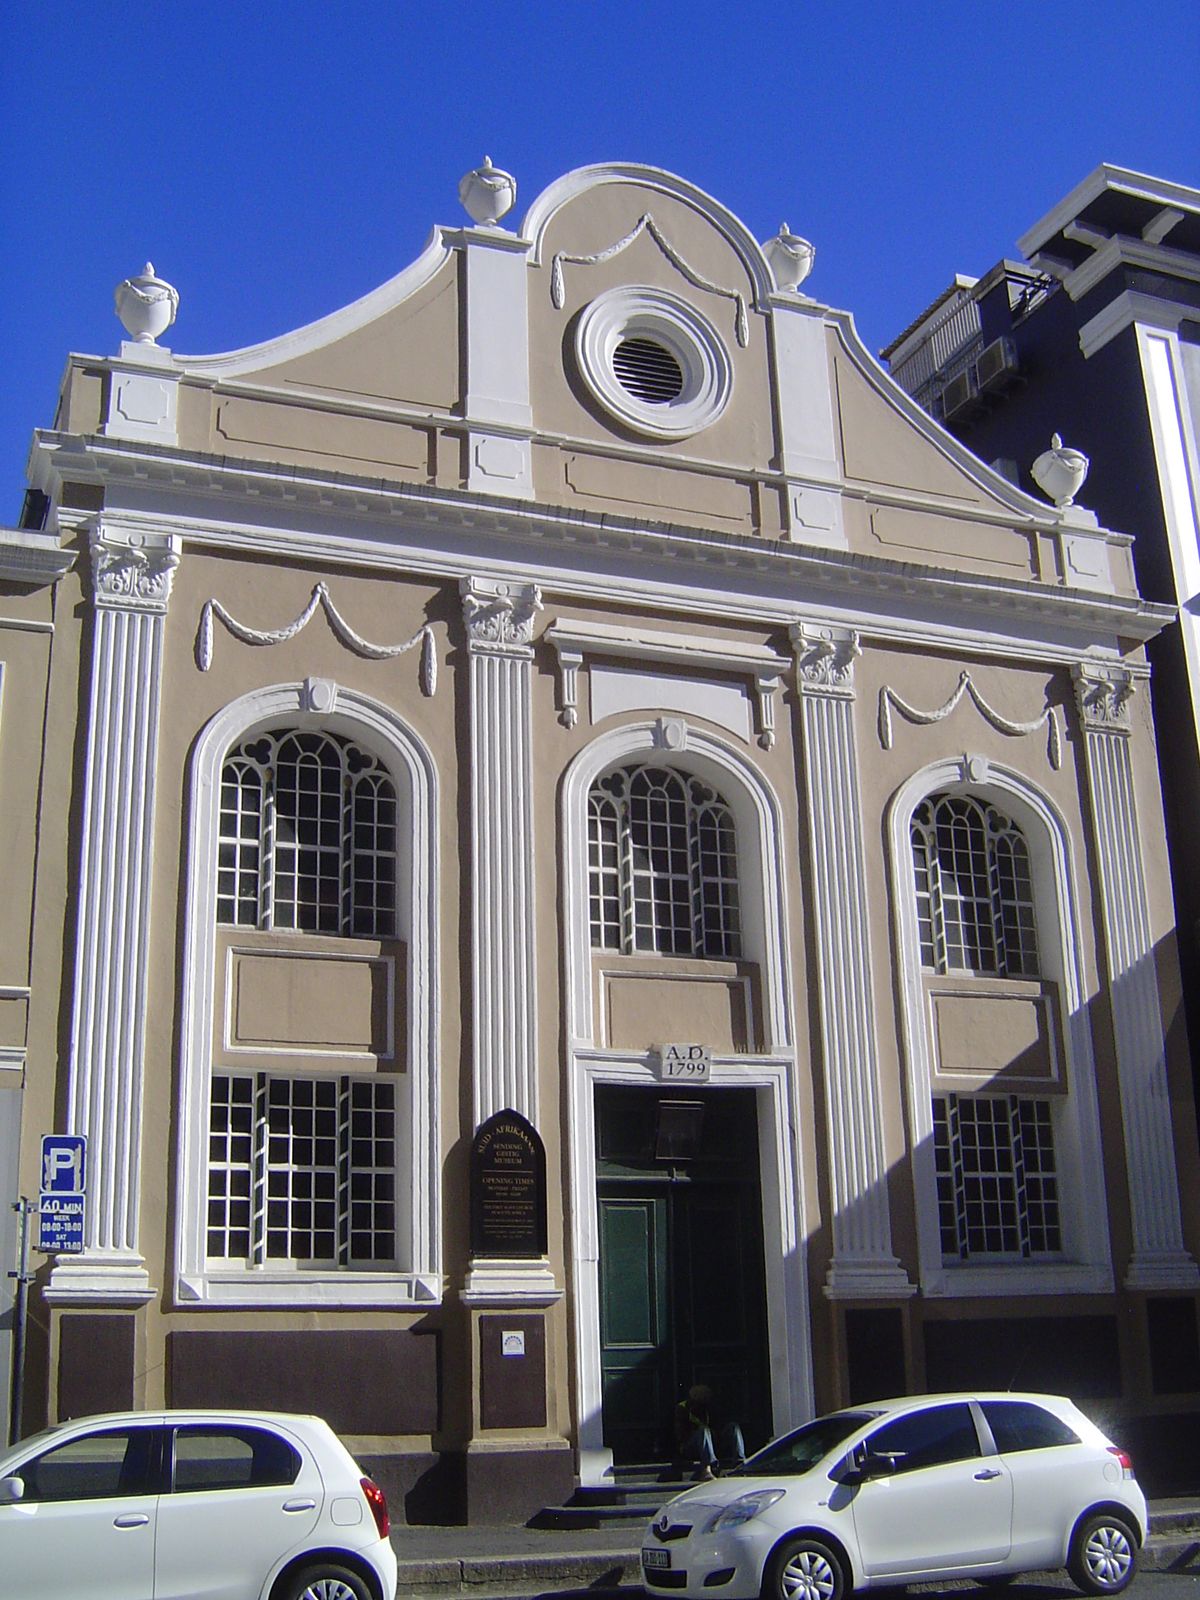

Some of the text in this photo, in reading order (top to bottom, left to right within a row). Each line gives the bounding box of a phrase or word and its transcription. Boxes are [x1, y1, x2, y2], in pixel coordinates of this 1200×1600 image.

[666, 1045, 708, 1061] A.D.
[668, 1062, 706, 1076] 1799
[50, 1147, 75, 1180] P
[43, 1199, 82, 1214] 60 MIN
[55, 1233, 67, 1241] SAT
